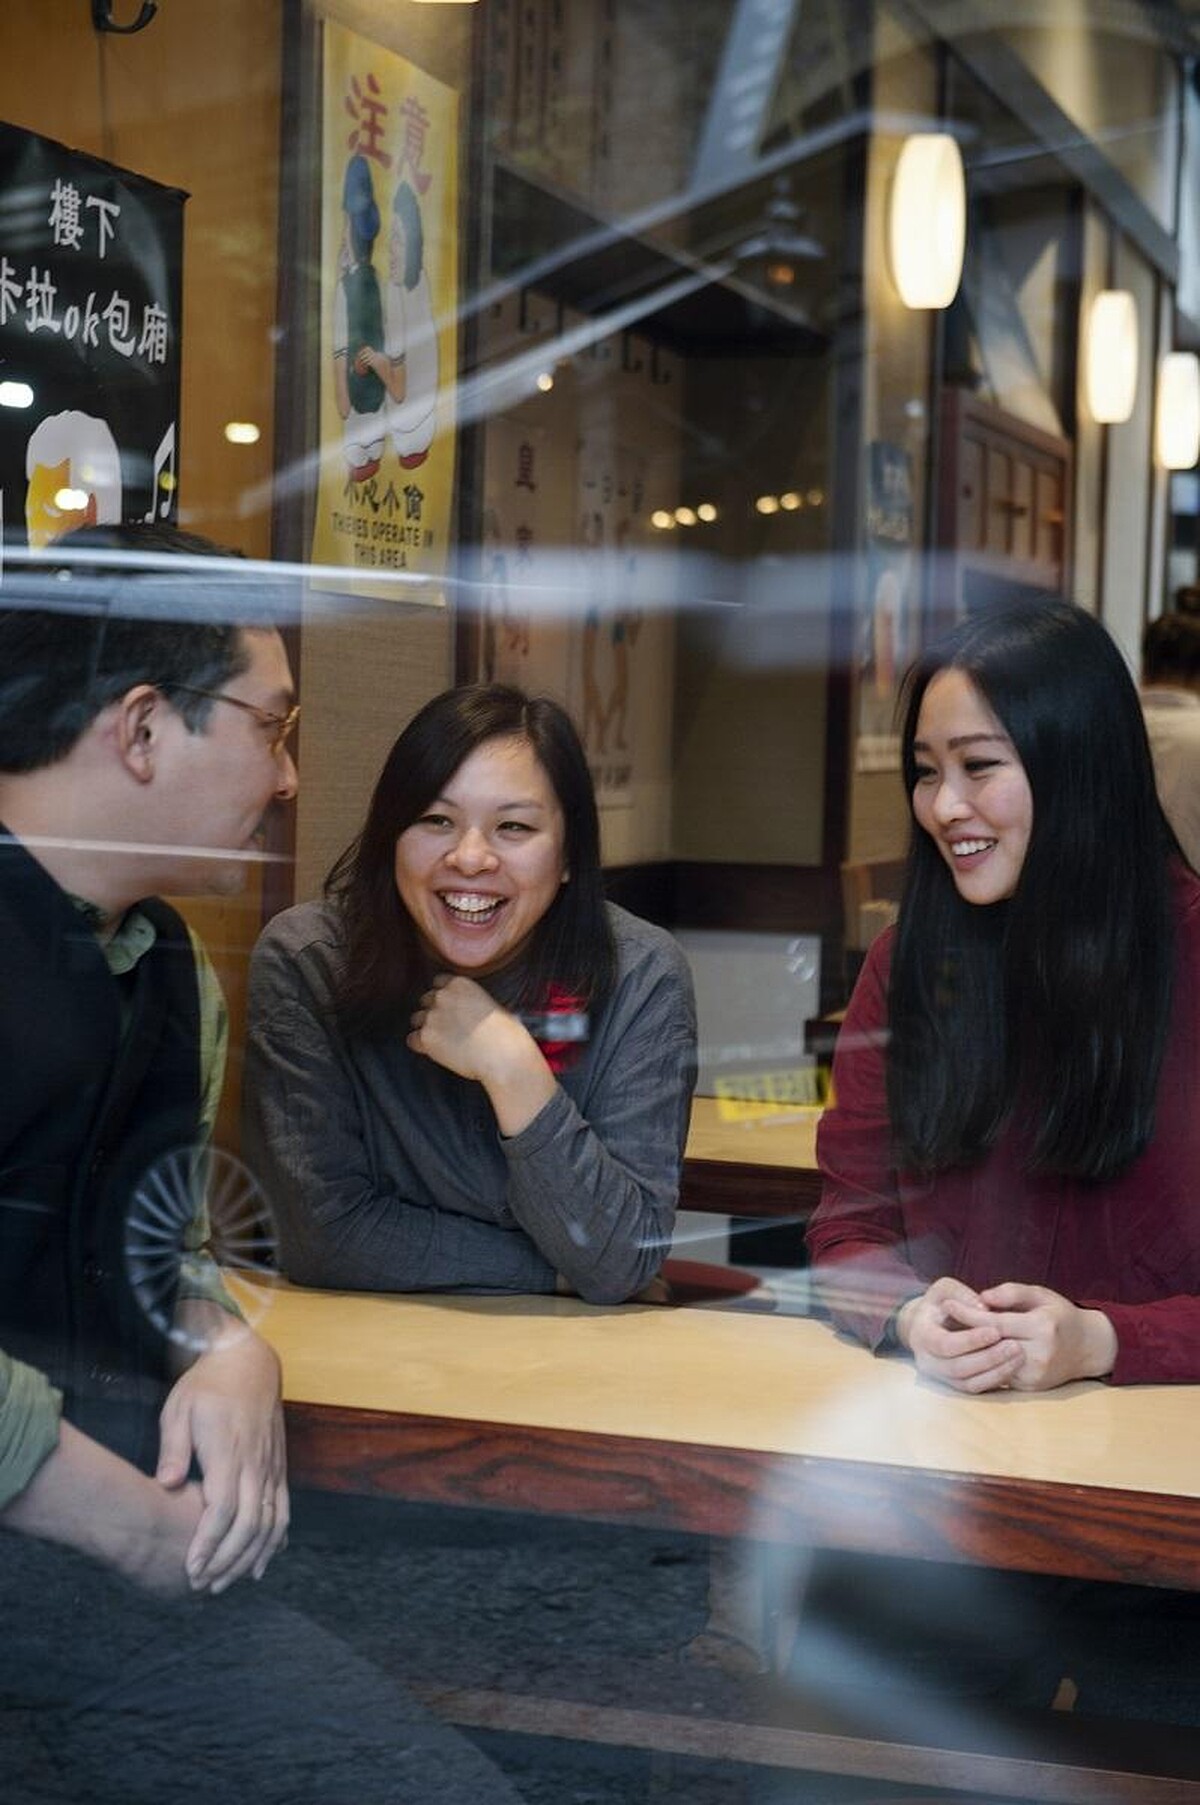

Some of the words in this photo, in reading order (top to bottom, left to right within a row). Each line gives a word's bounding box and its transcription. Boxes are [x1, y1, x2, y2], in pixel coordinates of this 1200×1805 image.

[344, 72, 433, 195] 注意
[49, 178, 121, 259] 樓下
[332, 511, 369, 539] THIEVES
[371, 520, 420, 547] OPERATE
[354, 542, 376, 566] THIS
[379, 547, 407, 569] AREA
